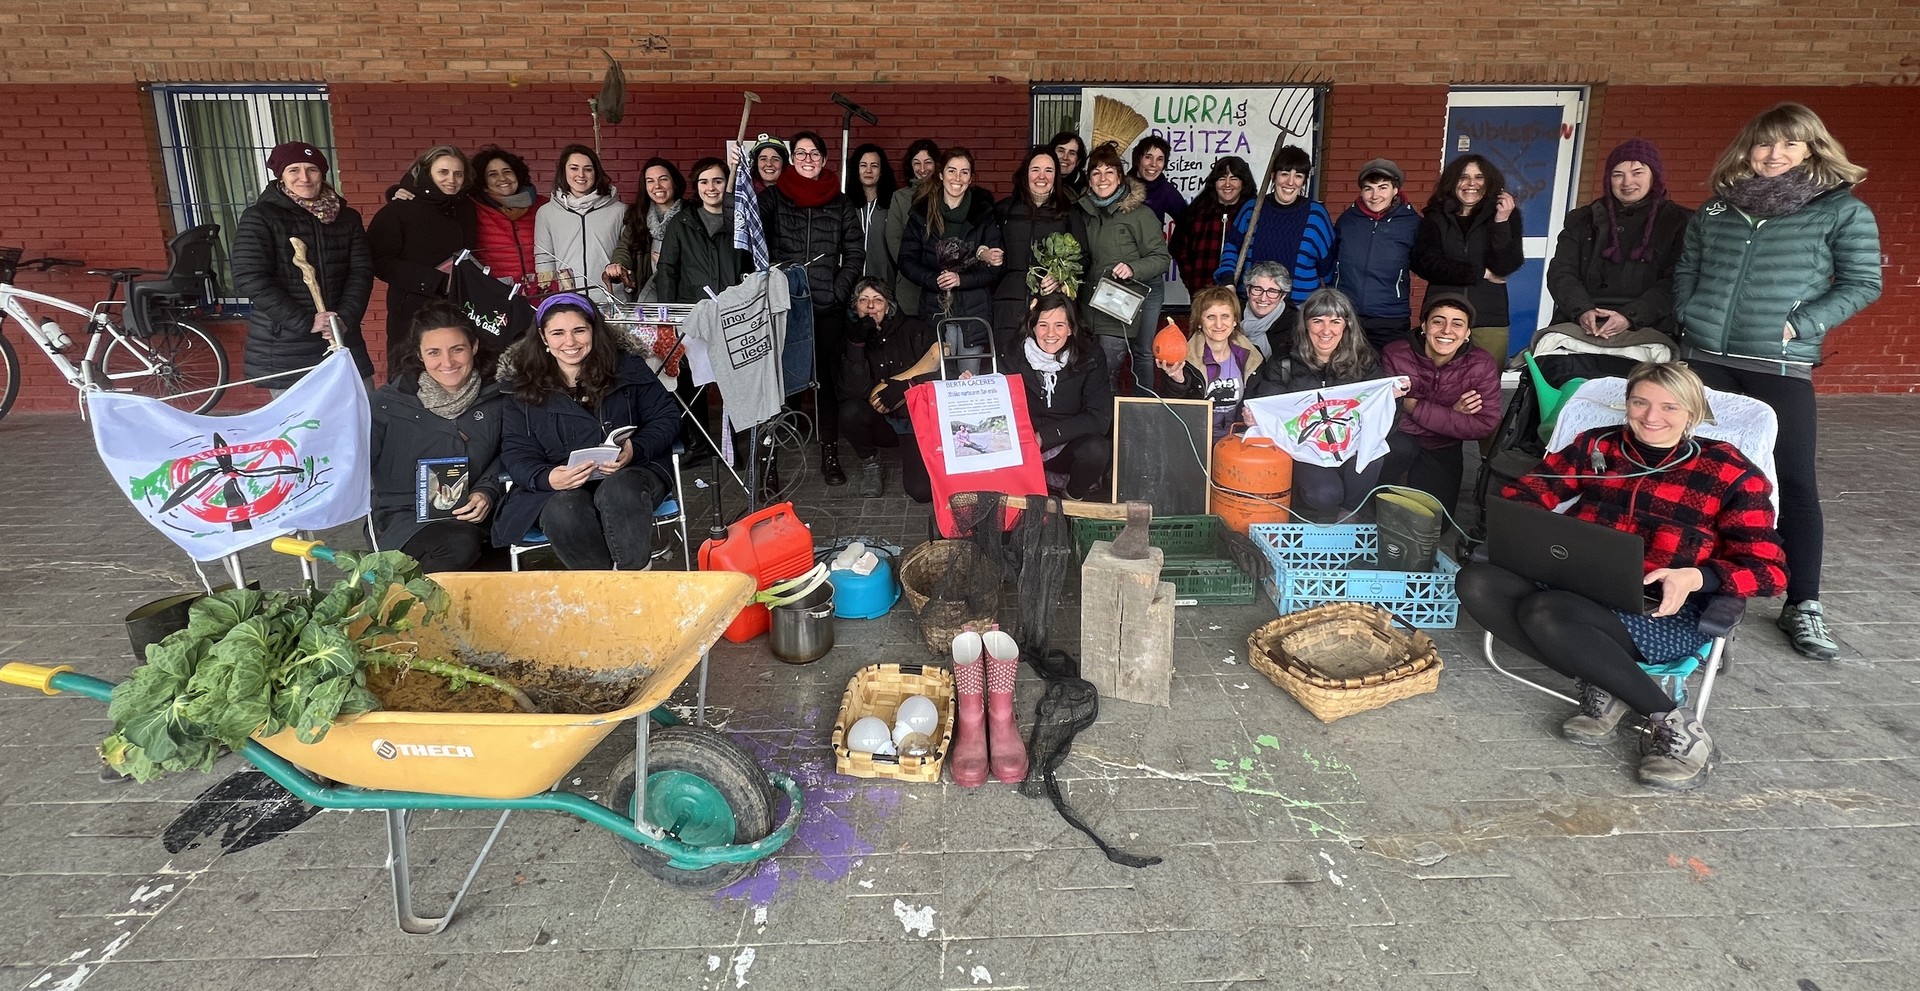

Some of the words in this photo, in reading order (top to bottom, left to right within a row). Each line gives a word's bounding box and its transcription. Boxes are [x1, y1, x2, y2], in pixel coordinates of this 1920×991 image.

[1153, 94, 1233, 124] LURRA
[1233, 98, 1248, 127] eta
[722, 312, 747, 327] inor
[750, 316, 764, 329] ez
[740, 335, 757, 347] da
[226, 504, 259, 521] EZ
[396, 743, 476, 759] THECA
